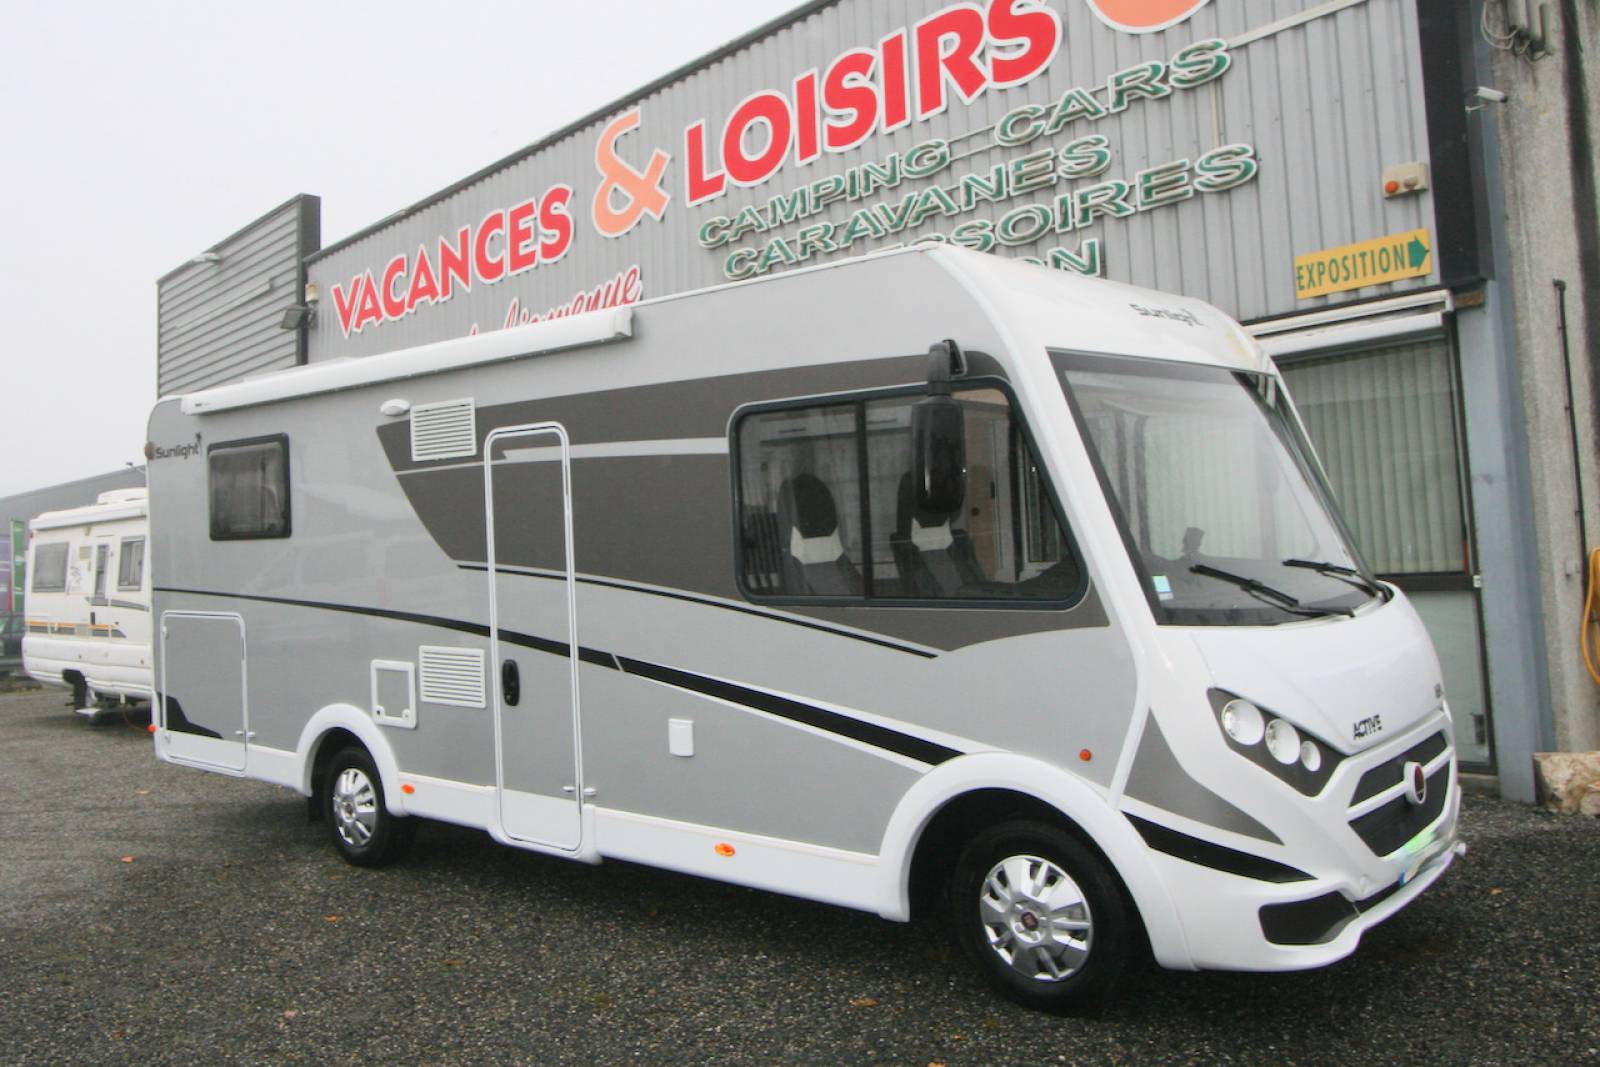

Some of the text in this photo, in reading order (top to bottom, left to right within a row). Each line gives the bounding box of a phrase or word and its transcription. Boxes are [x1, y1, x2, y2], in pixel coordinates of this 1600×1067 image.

[331, 0, 1062, 339] VACANCES & LOISIRS
[699, 38, 1231, 248] CAMPING CARS
[868, 143, 1258, 252] SOIRES
[723, 134, 1111, 281] CARAVANES
[1296, 243, 1406, 291] EXPOSITION
[155, 442, 200, 461] Sunlight
[1353, 713, 1382, 741] ACTIVE
